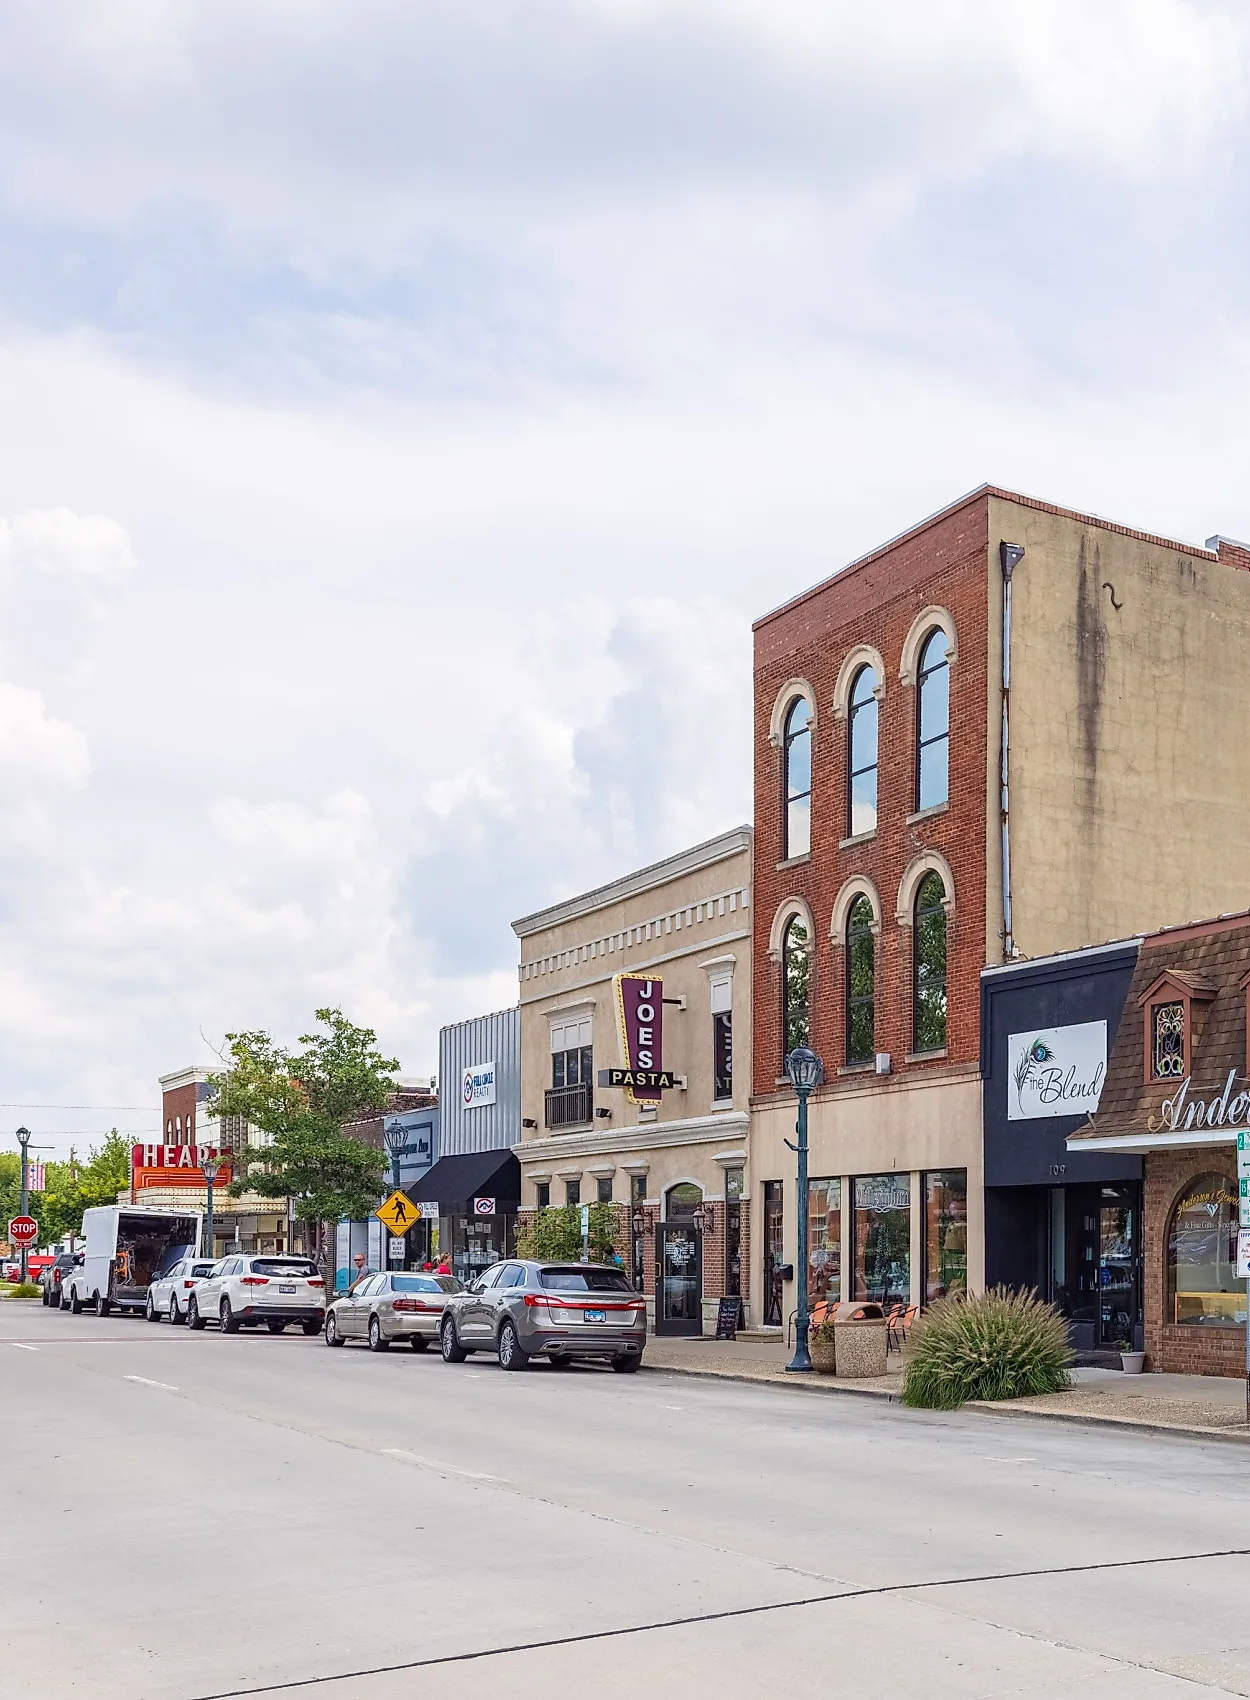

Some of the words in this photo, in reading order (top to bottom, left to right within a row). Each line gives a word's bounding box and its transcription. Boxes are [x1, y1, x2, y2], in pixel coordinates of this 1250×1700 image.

[636, 981, 655, 1069] JOES
[612, 1071, 670, 1087] PASTA
[1029, 1076, 1045, 1091] the
[1040, 1061, 1104, 1104] Blend
[1238, 1135, 1243, 1148] 2
[143, 1144, 223, 1168] HEART
[1049, 1164, 1066, 1176] 109
[1241, 1183, 1247, 1193] 15
[11, 1223, 36, 1234] STOP
